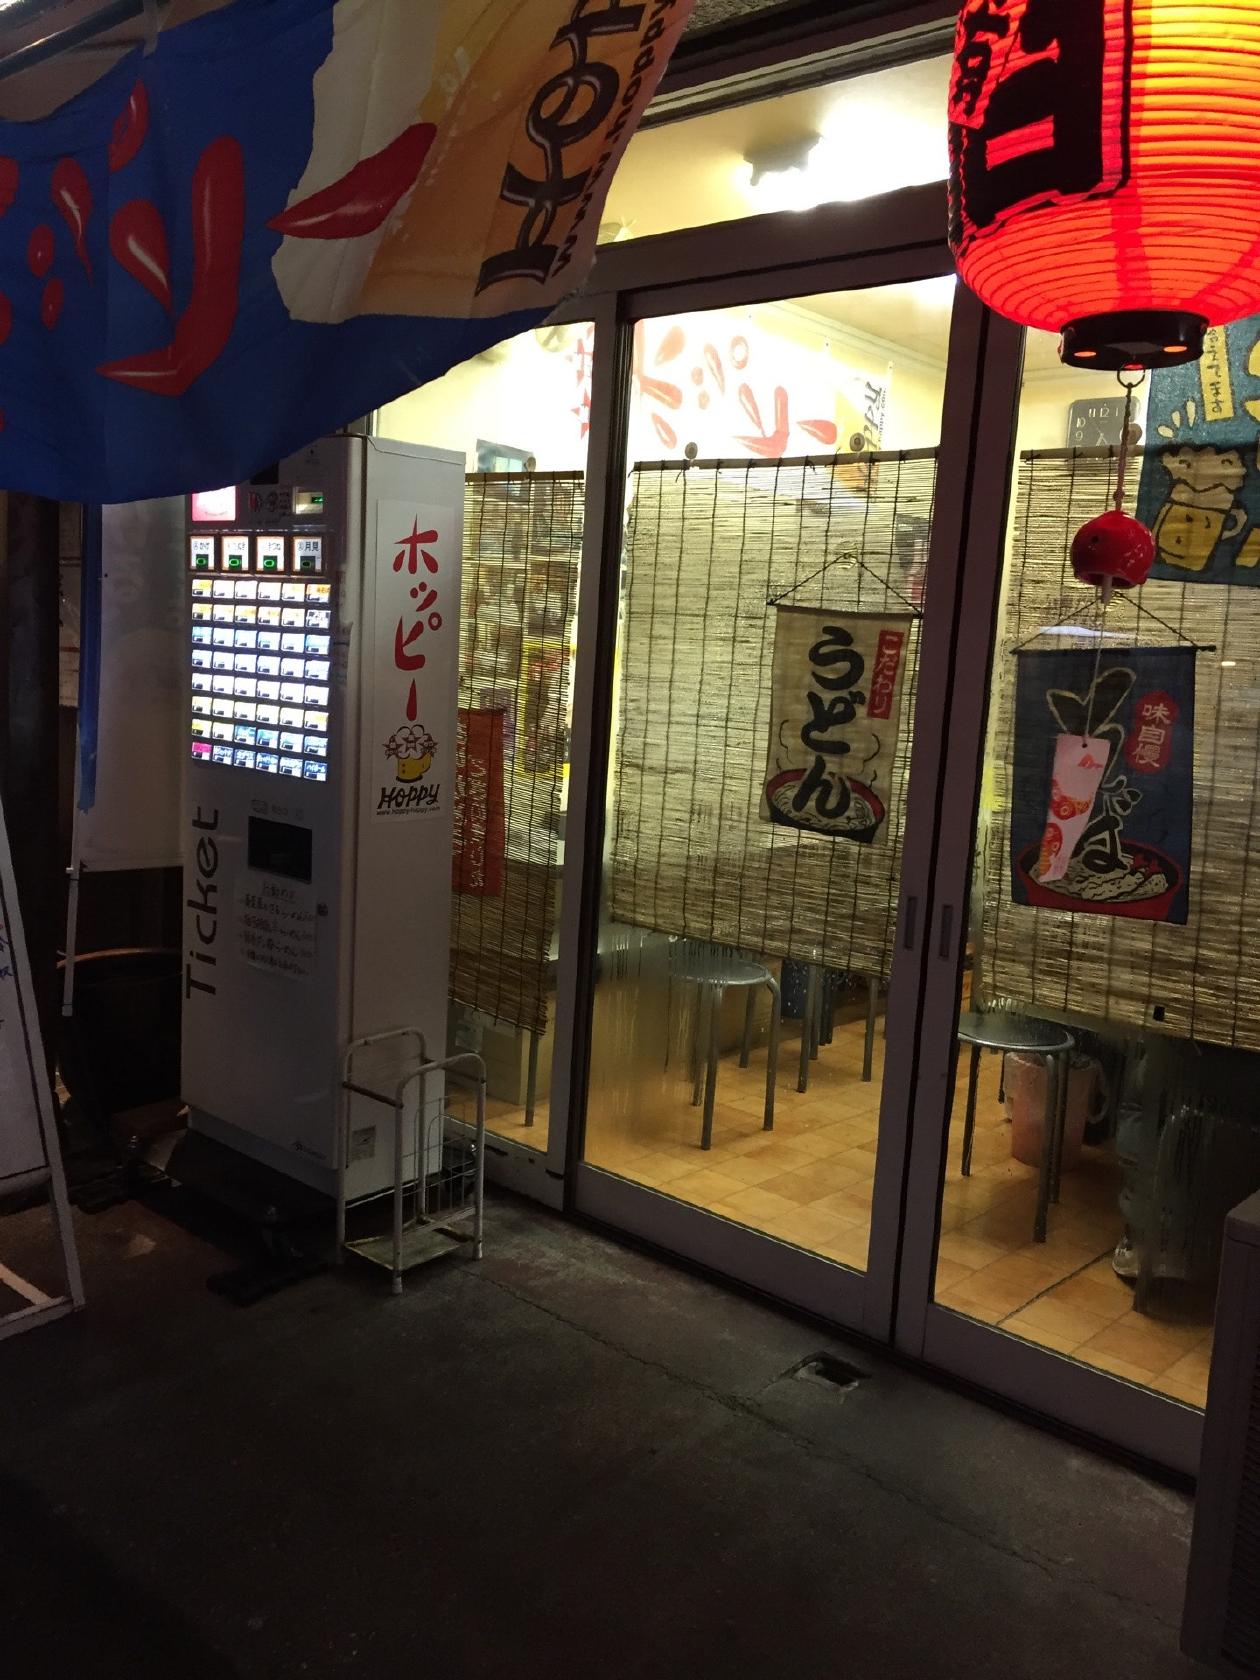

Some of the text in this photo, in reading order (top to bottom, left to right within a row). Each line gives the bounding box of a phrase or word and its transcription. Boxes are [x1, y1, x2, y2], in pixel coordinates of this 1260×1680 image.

[1075, 430, 1083, 441] 9
[1076, 417, 1086, 428] 10
[1099, 407, 1110, 418] 12
[393, 513, 442, 722] ホッピー
[871, 634, 901, 715] こだわり
[792, 625, 866, 819] うどん
[1131, 703, 1172, 768] 味自慢
[377, 784, 440, 809] Hoppy
[185, 806, 219, 1000] Ticket
